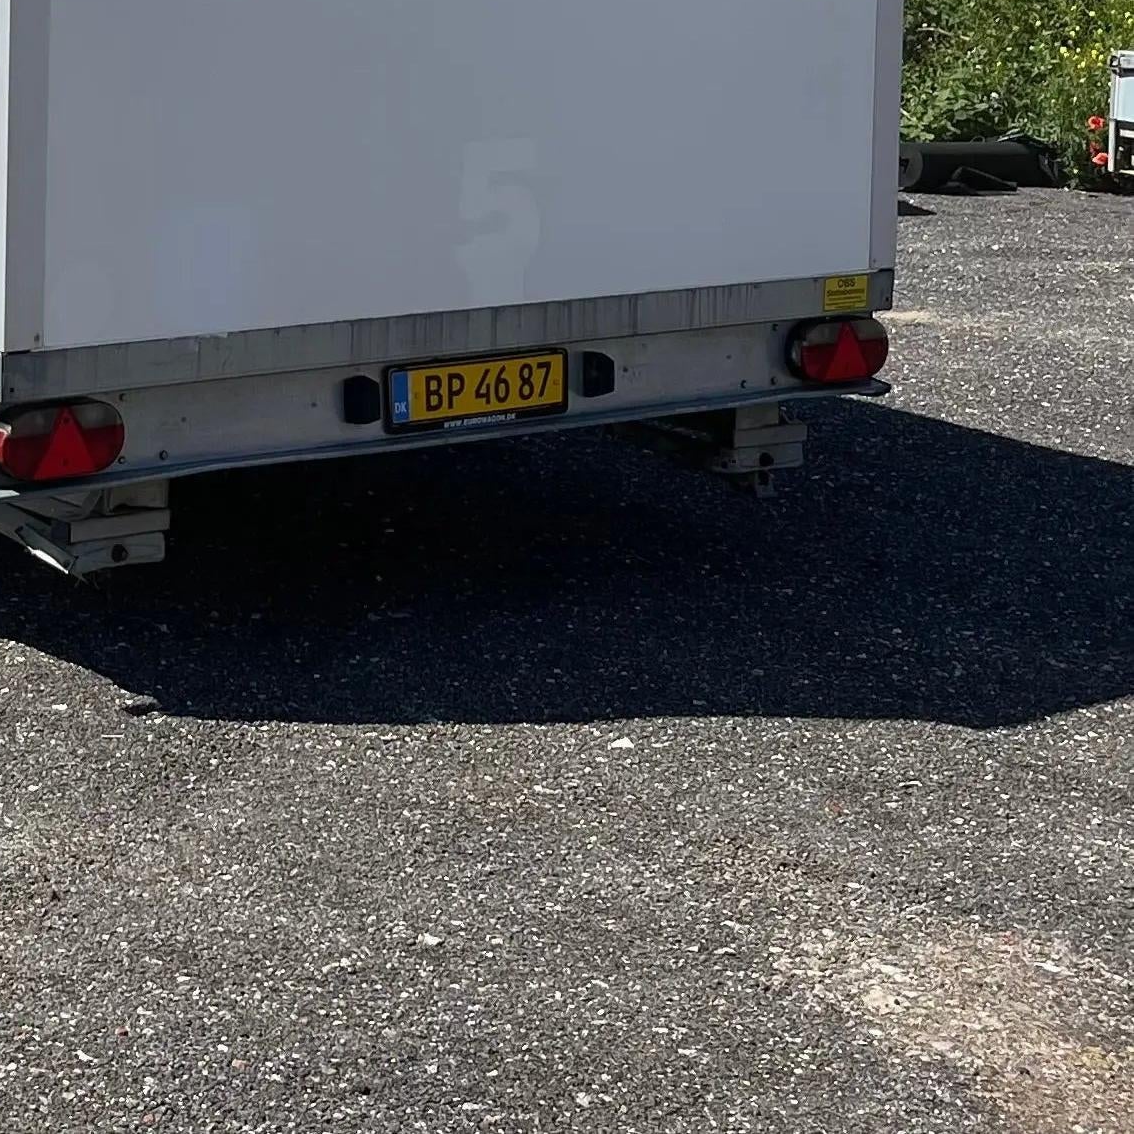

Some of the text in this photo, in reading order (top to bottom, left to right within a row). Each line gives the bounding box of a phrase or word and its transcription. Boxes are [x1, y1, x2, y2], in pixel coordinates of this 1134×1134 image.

[424, 361, 553, 413] BP 46 87
[394, 402, 408, 414] DK
